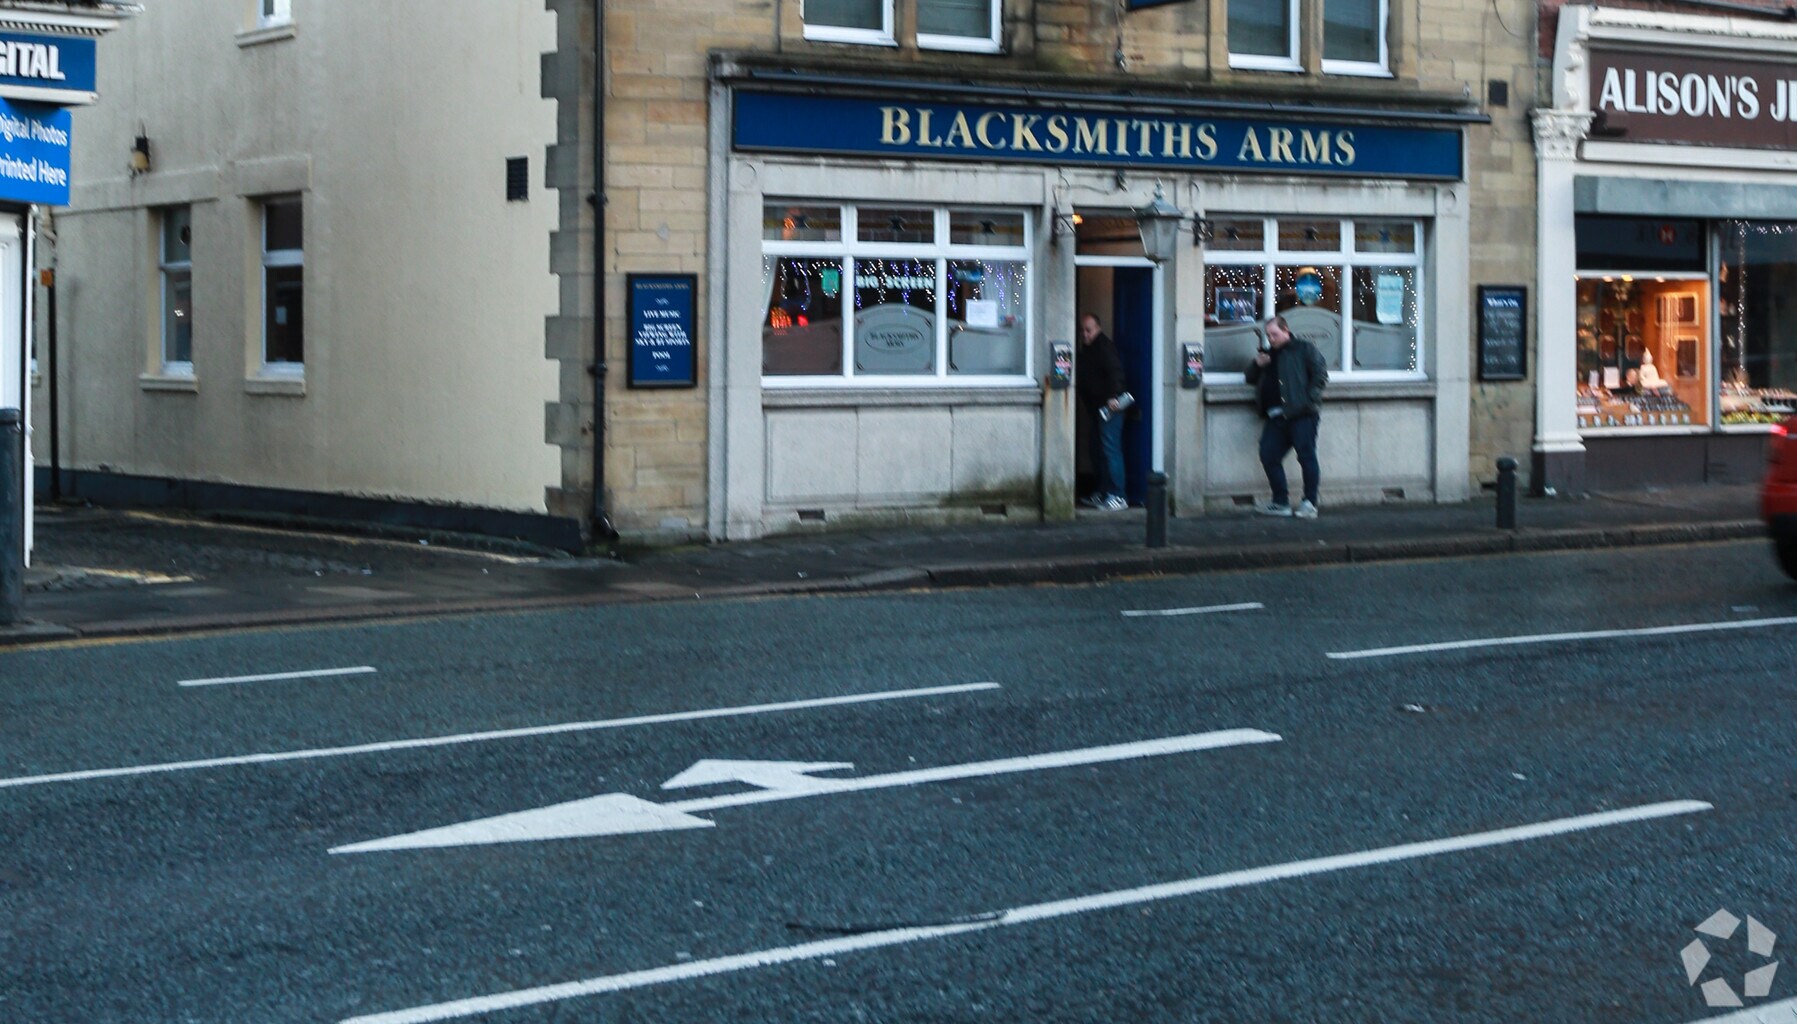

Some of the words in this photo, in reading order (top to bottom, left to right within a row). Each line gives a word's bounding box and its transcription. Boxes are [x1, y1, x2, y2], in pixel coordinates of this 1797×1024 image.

[1599, 67, 1760, 120] ALISON'S
[31, 118, 68, 147] Photos
[879, 106, 1218, 160] BLACKSMITHS
[1237, 126, 1356, 166] ARMS
[0, 153, 37, 182] rinted
[38, 159, 67, 187] Here
[855, 275, 880, 288] BIG
[886, 275, 935, 289] SCREEN
